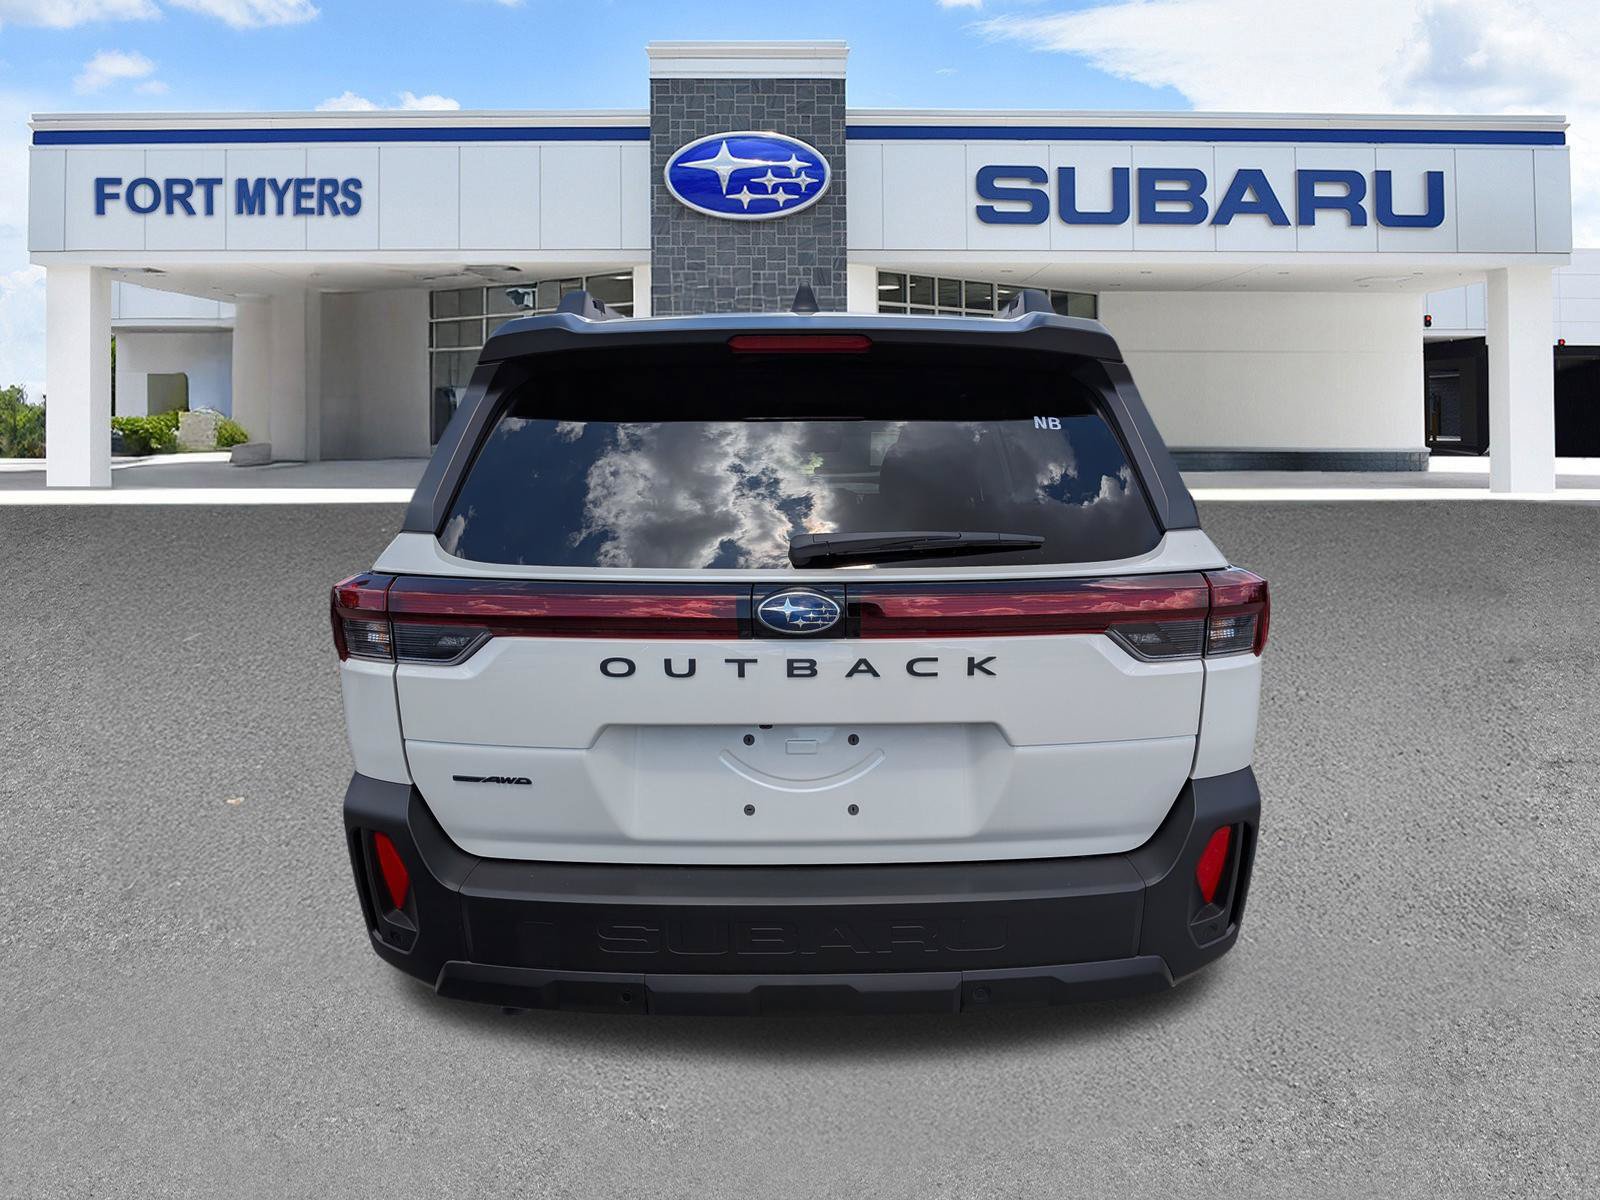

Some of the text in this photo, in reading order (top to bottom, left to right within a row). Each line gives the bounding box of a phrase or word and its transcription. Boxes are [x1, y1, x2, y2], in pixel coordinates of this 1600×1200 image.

[95, 177, 363, 217] FORT MYERS
[975, 165, 1446, 229] SUBARU
[1033, 416, 1062, 430] NB
[599, 656, 998, 678] OUTBACK
[481, 776, 532, 785] AWD
[597, 921, 1009, 956] SUBARU
